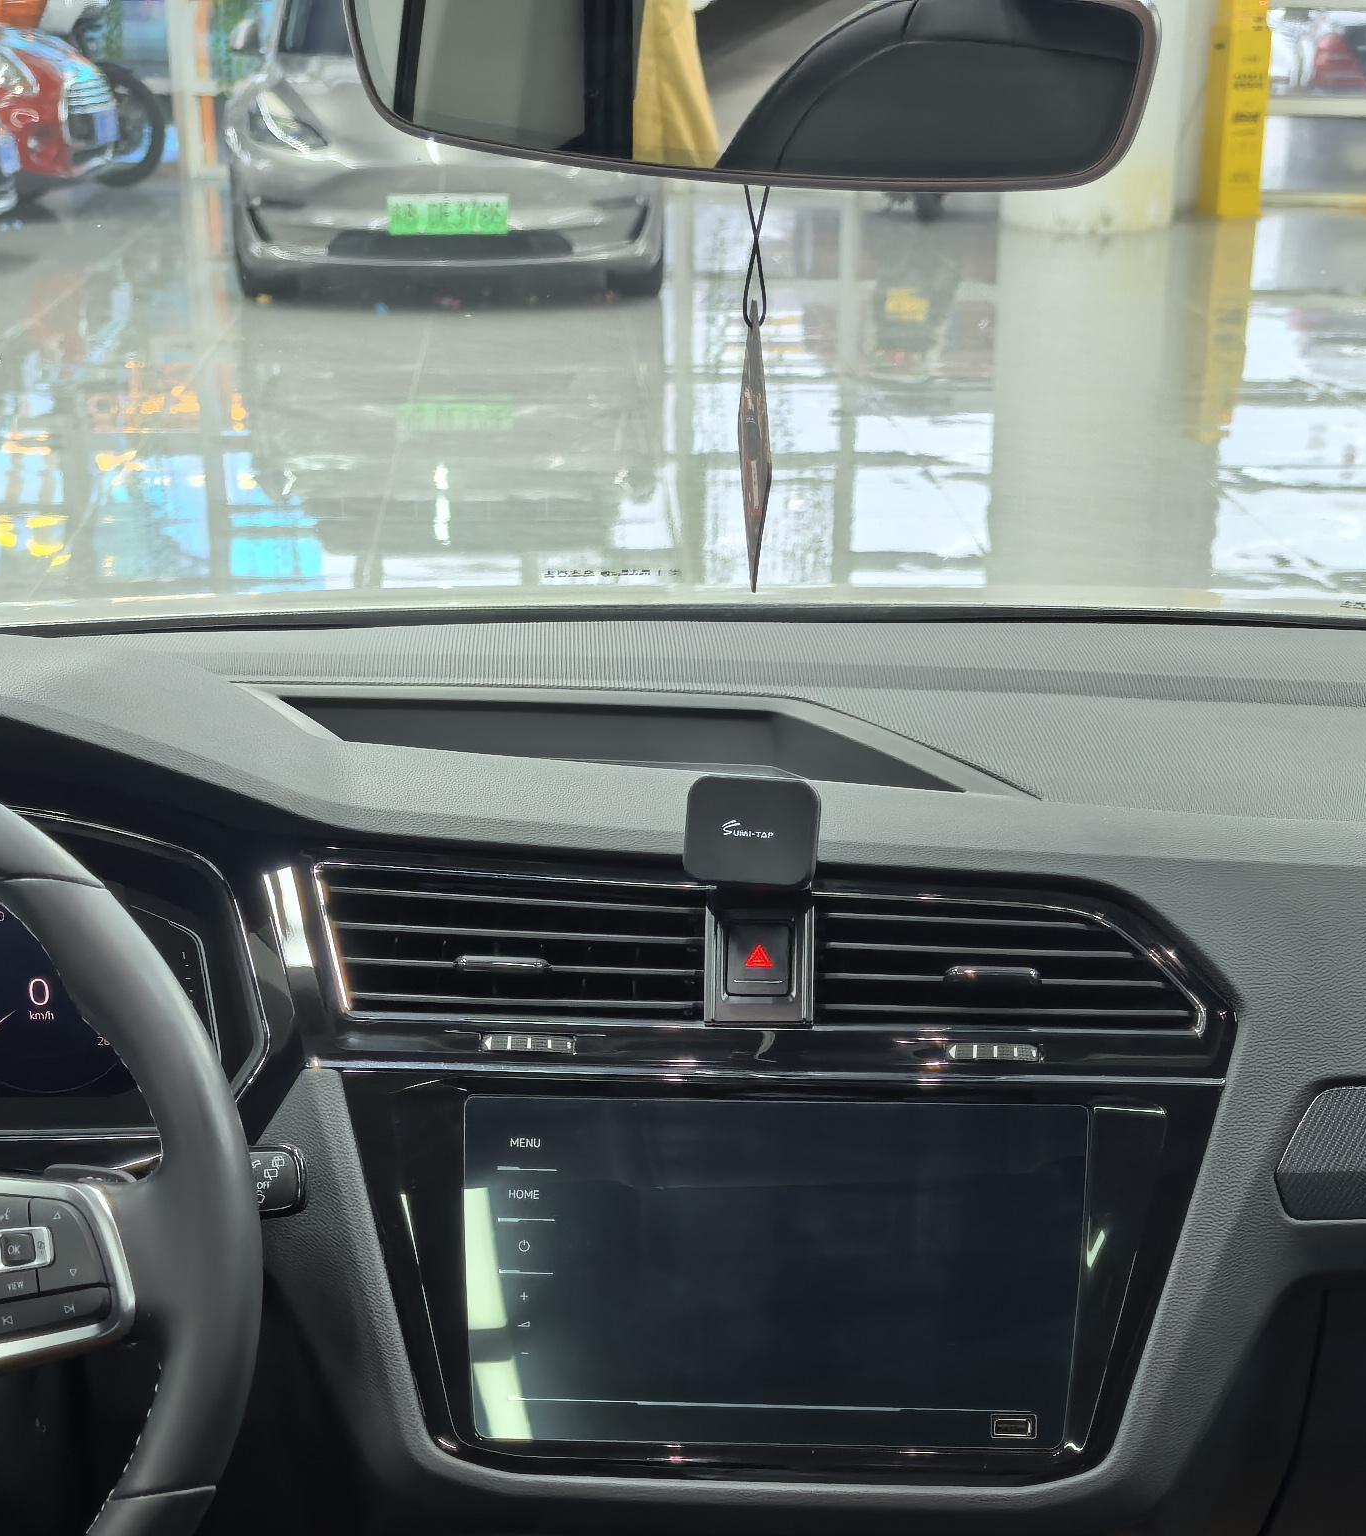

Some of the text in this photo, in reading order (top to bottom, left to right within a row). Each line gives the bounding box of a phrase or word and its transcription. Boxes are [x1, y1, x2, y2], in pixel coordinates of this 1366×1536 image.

[28, 978, 50, 1006] 0
[29, 1010, 55, 1021] km/h
[510, 1137, 542, 1149] MENU
[508, 1189, 540, 1200] HOME
[7, 1244, 21, 1255] OK
[7, 1280, 25, 1292] VIEW
